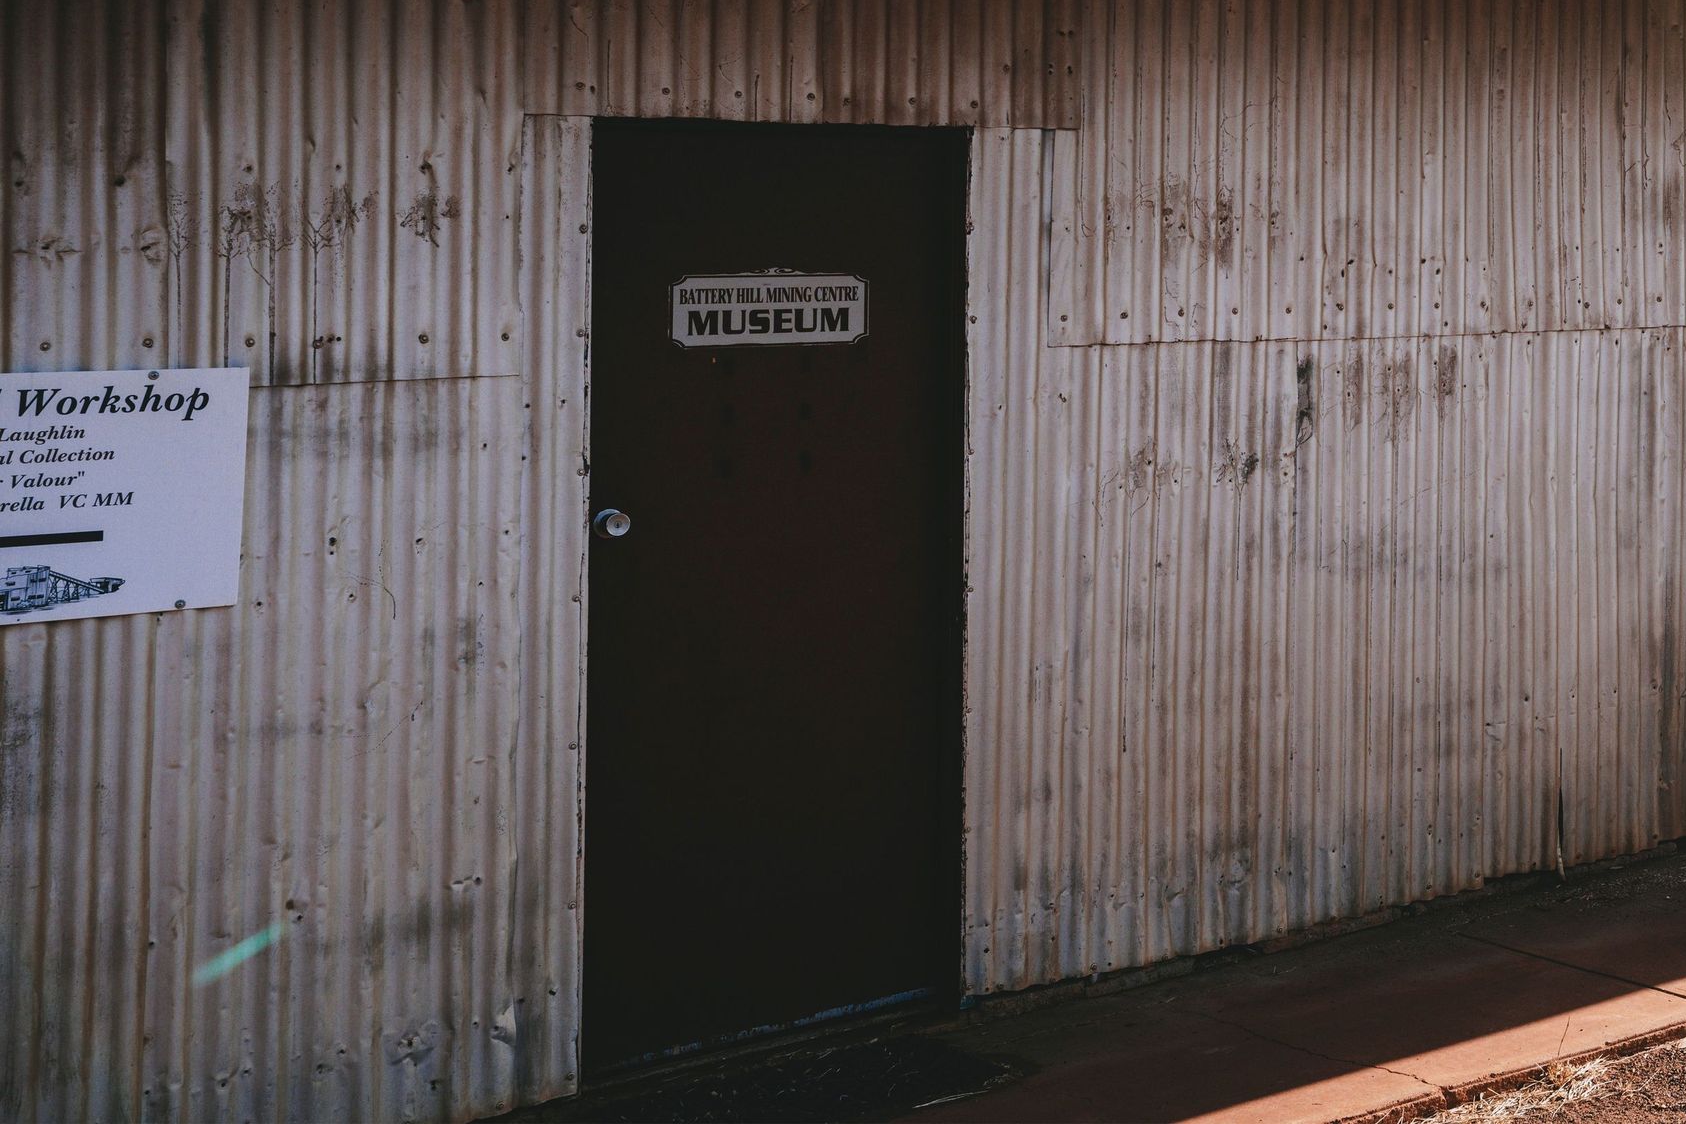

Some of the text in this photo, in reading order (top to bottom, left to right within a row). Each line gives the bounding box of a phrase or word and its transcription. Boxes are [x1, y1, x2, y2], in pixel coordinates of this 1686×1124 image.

[679, 285, 859, 305] BATTERY HILL MINING CENTRE
[687, 307, 849, 336] MUSEUM
[17, 384, 210, 421] Workshop
[19, 447, 116, 465] Collection
[10, 471, 86, 489] Valour"
[59, 493, 88, 509] VC
[92, 491, 135, 507] MM
